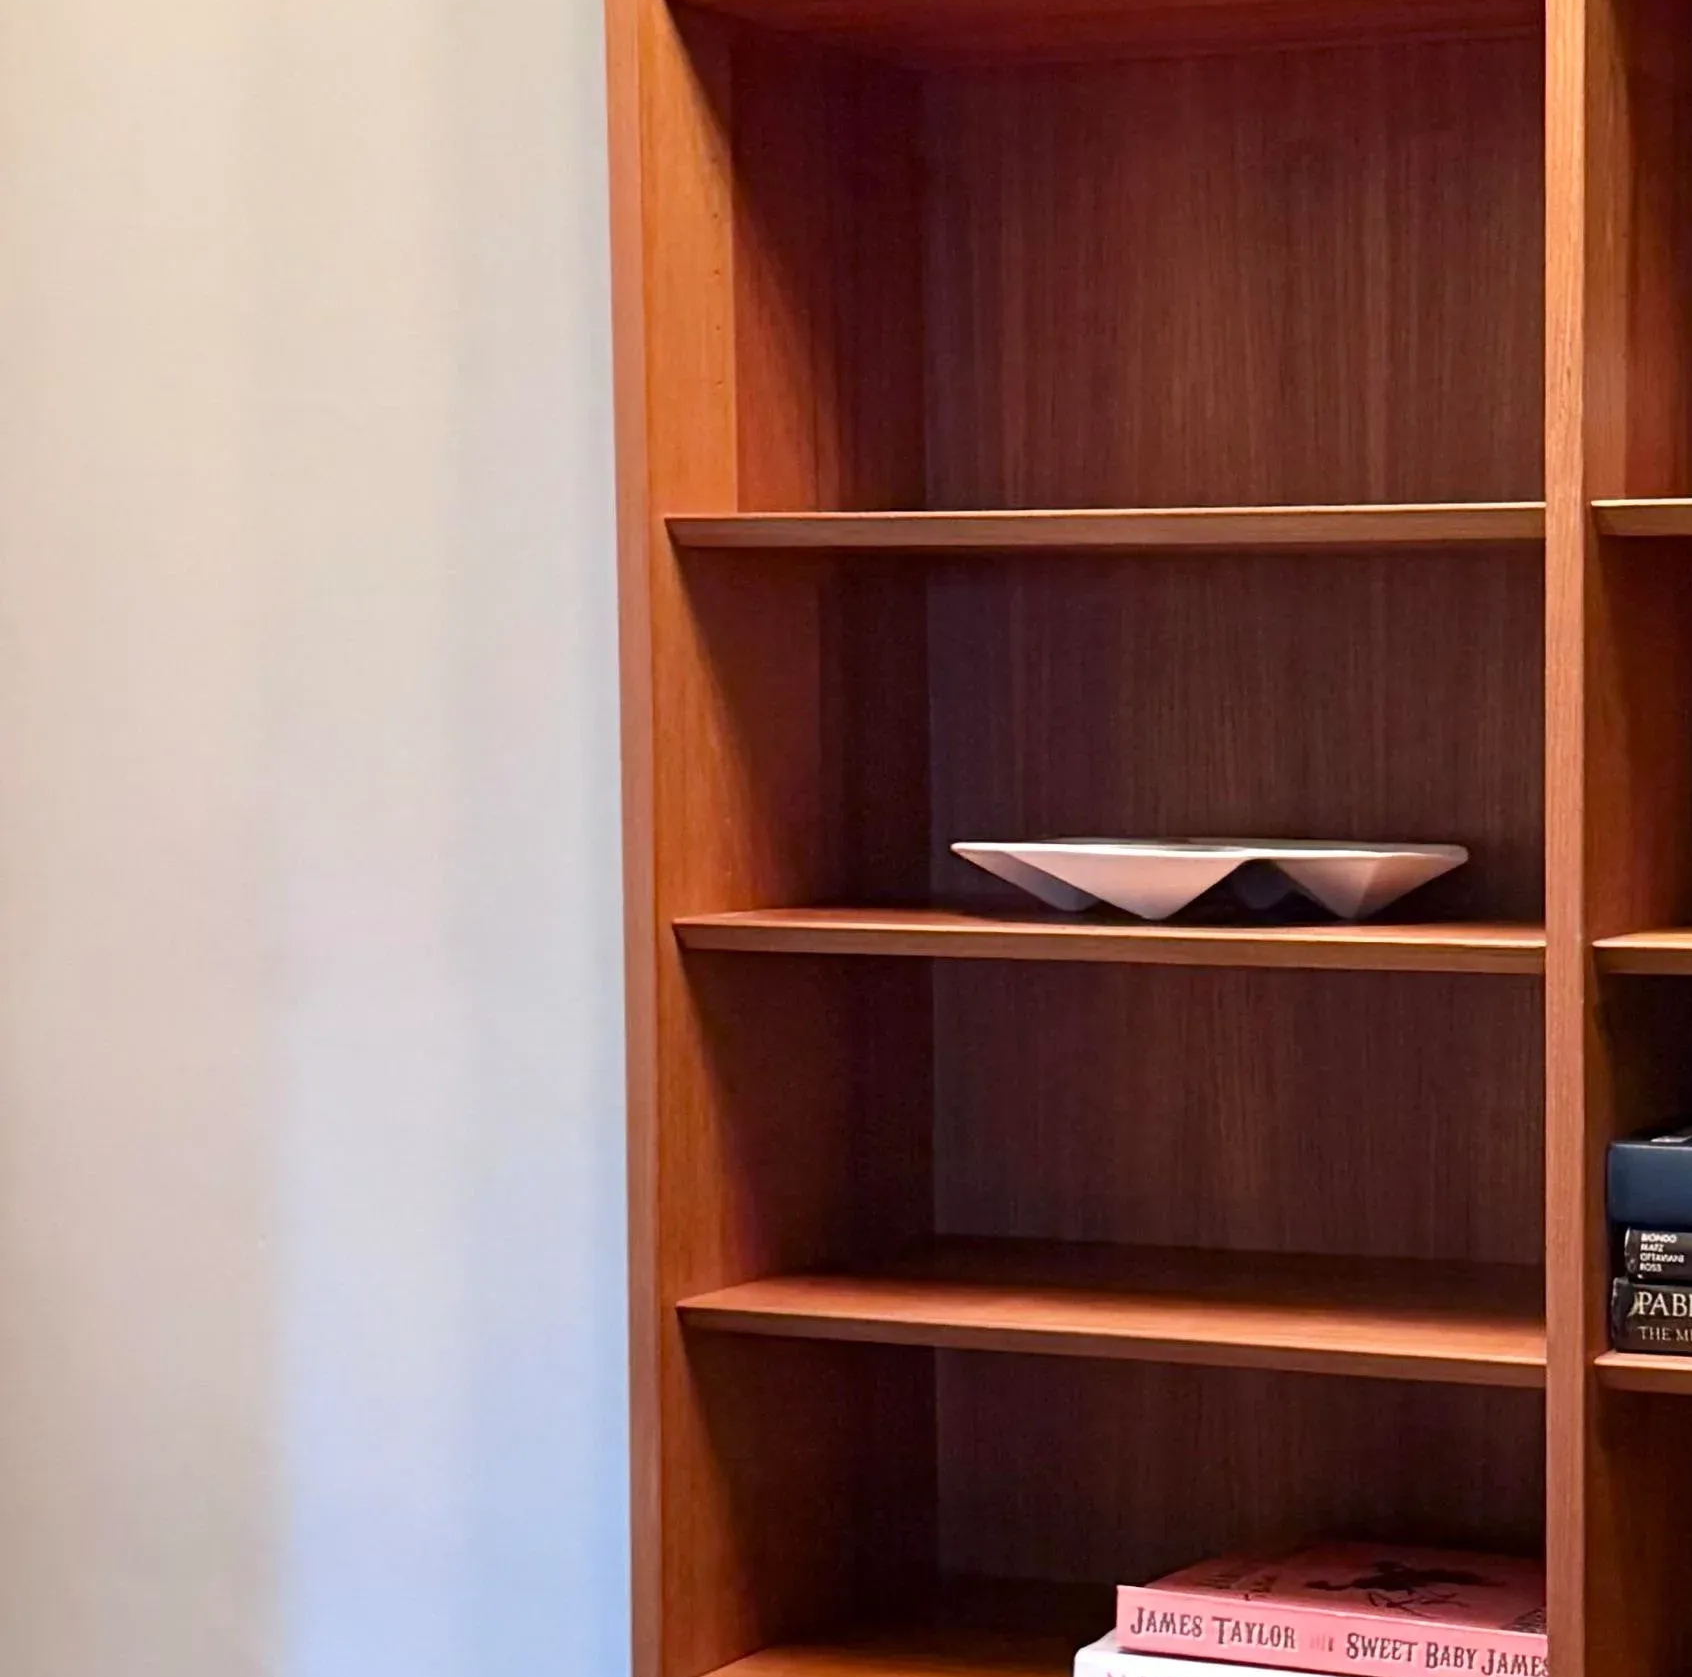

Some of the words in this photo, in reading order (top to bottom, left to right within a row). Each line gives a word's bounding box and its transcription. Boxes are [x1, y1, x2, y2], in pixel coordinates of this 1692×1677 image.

[1638, 1325, 1671, 1342] THE
[1130, 1606, 1203, 1638] JAMES
[1212, 1615, 1296, 1649] TAYLOR
[1345, 1631, 1418, 1663] SWEET
[1425, 1641, 1478, 1670] BABY
